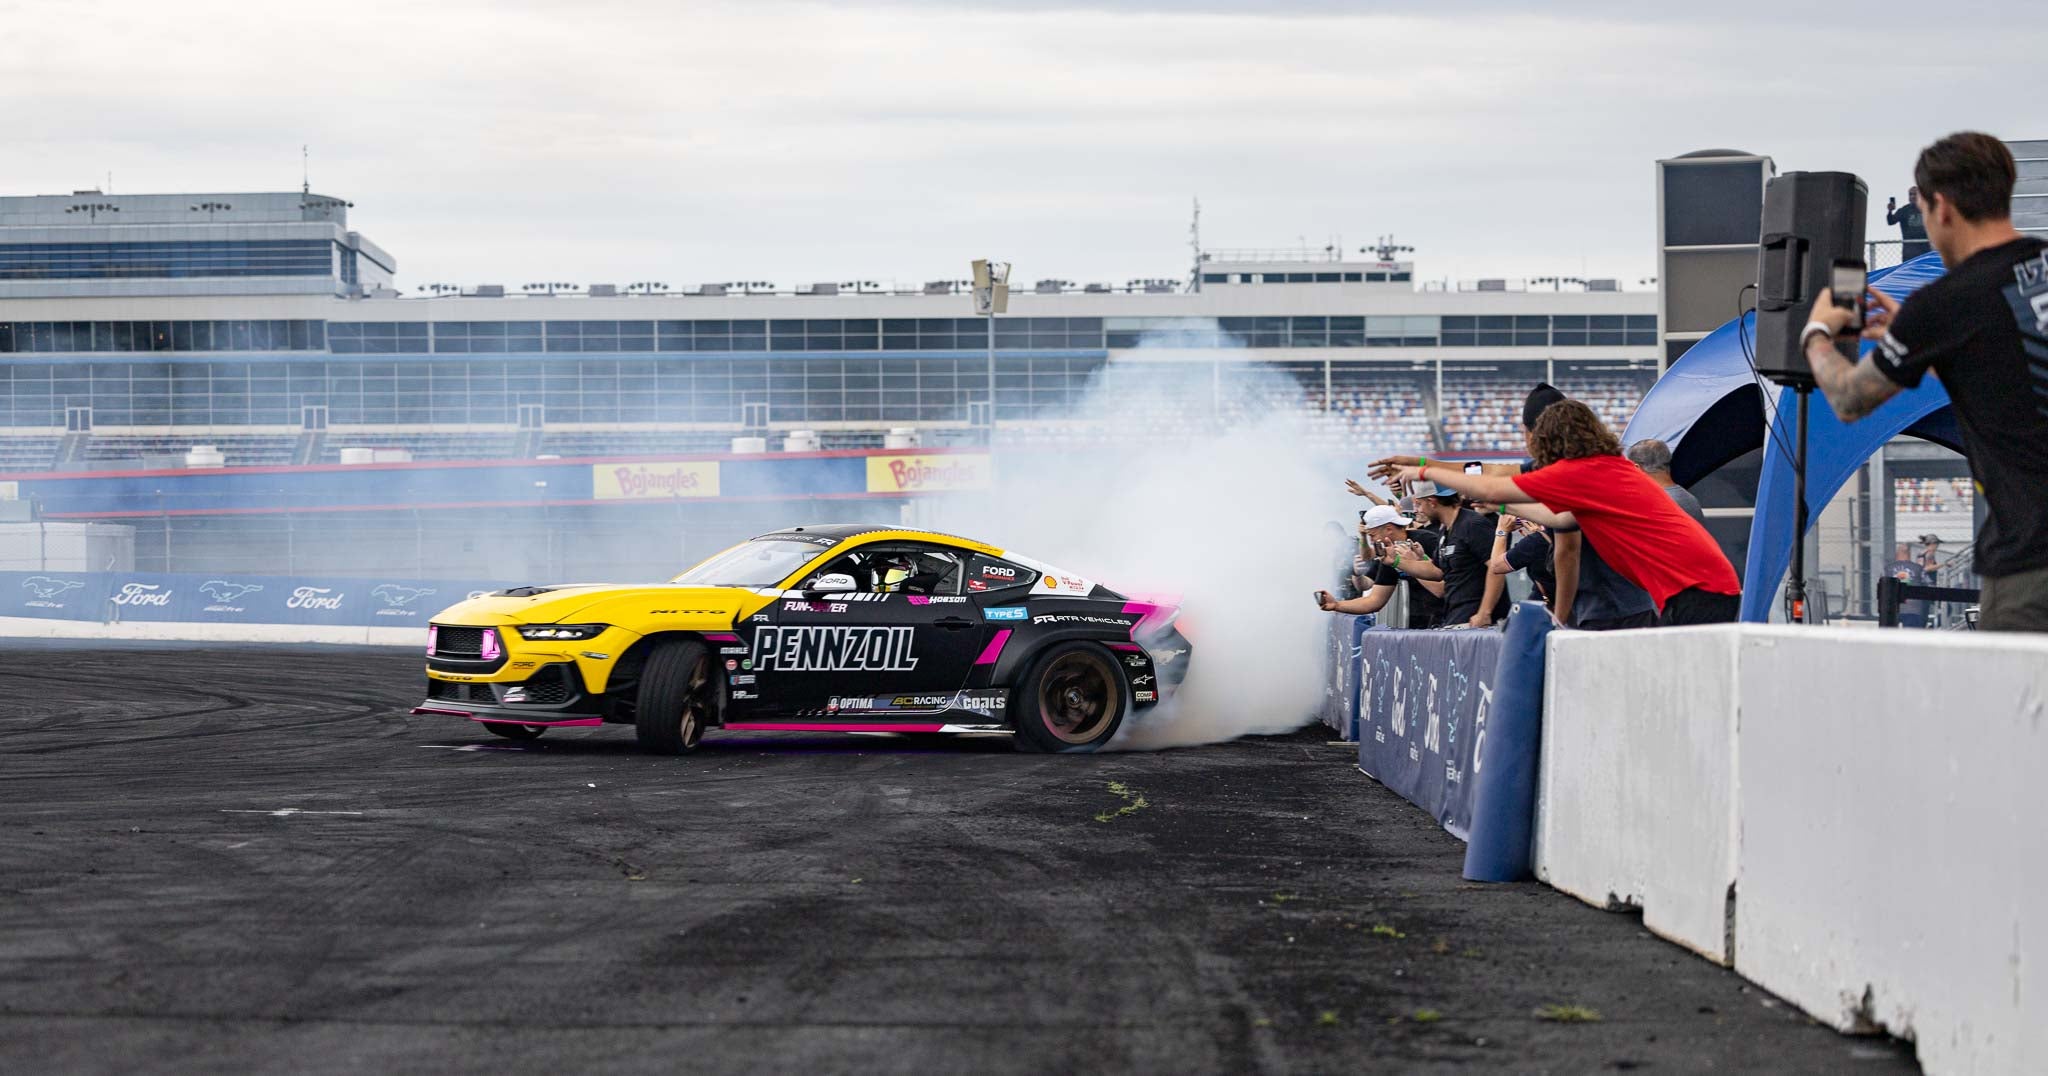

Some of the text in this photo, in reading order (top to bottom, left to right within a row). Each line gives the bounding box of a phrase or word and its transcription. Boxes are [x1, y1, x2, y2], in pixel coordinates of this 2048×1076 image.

[614, 466, 698, 496] Bojangles
[888, 459, 976, 488] Bojangles
[983, 566, 1015, 577] FORD
[111, 582, 172, 606] Ford
[286, 586, 344, 610] Ford
[784, 601, 848, 613] FUN-VER
[1080, 616, 1131, 626] VEHICLES
[752, 625, 919, 671] PENNZOIL
[840, 697, 873, 709] OPTIMA
[914, 696, 946, 705] RACING
